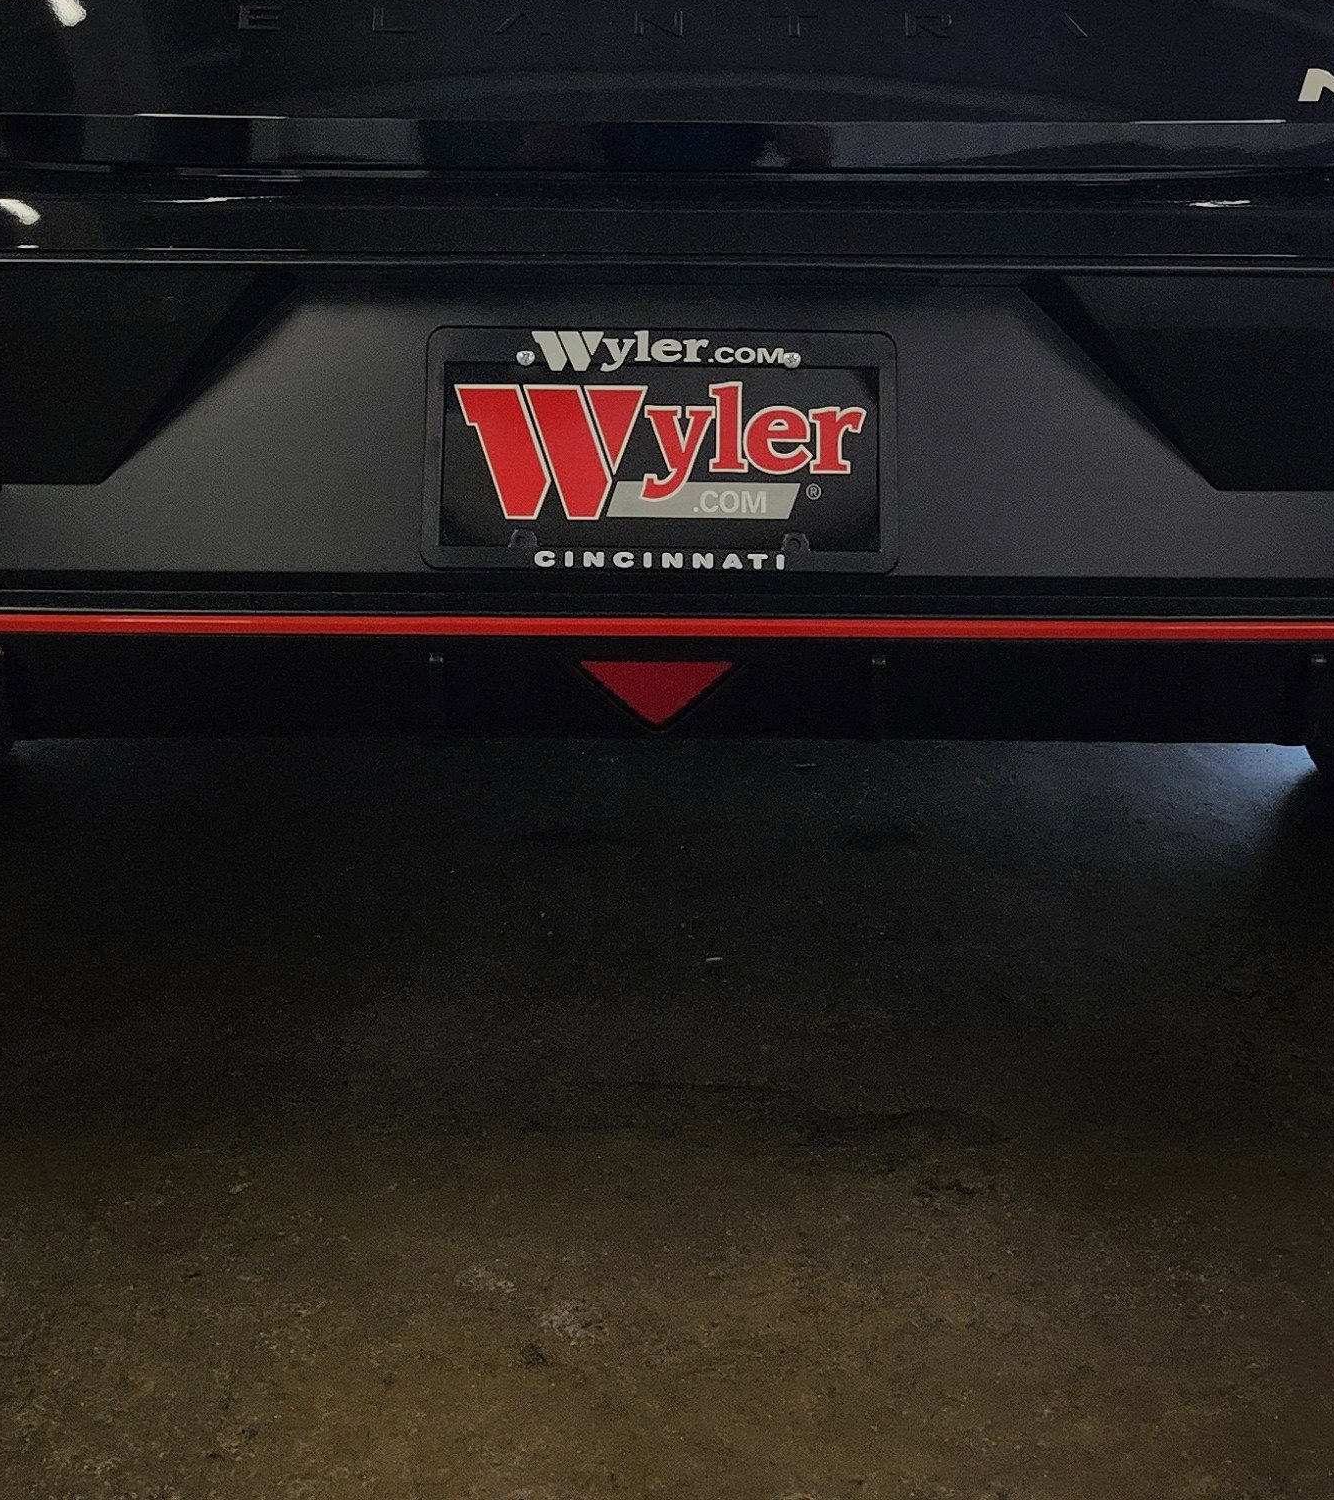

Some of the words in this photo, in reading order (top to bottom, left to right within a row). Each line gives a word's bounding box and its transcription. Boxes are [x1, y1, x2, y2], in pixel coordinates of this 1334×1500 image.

[237, 3, 1089, 38] ELANTRA
[454, 381, 867, 521] Wyler
[692, 489, 768, 514] .COM
[533, 549, 786, 571] CINCINNATI
